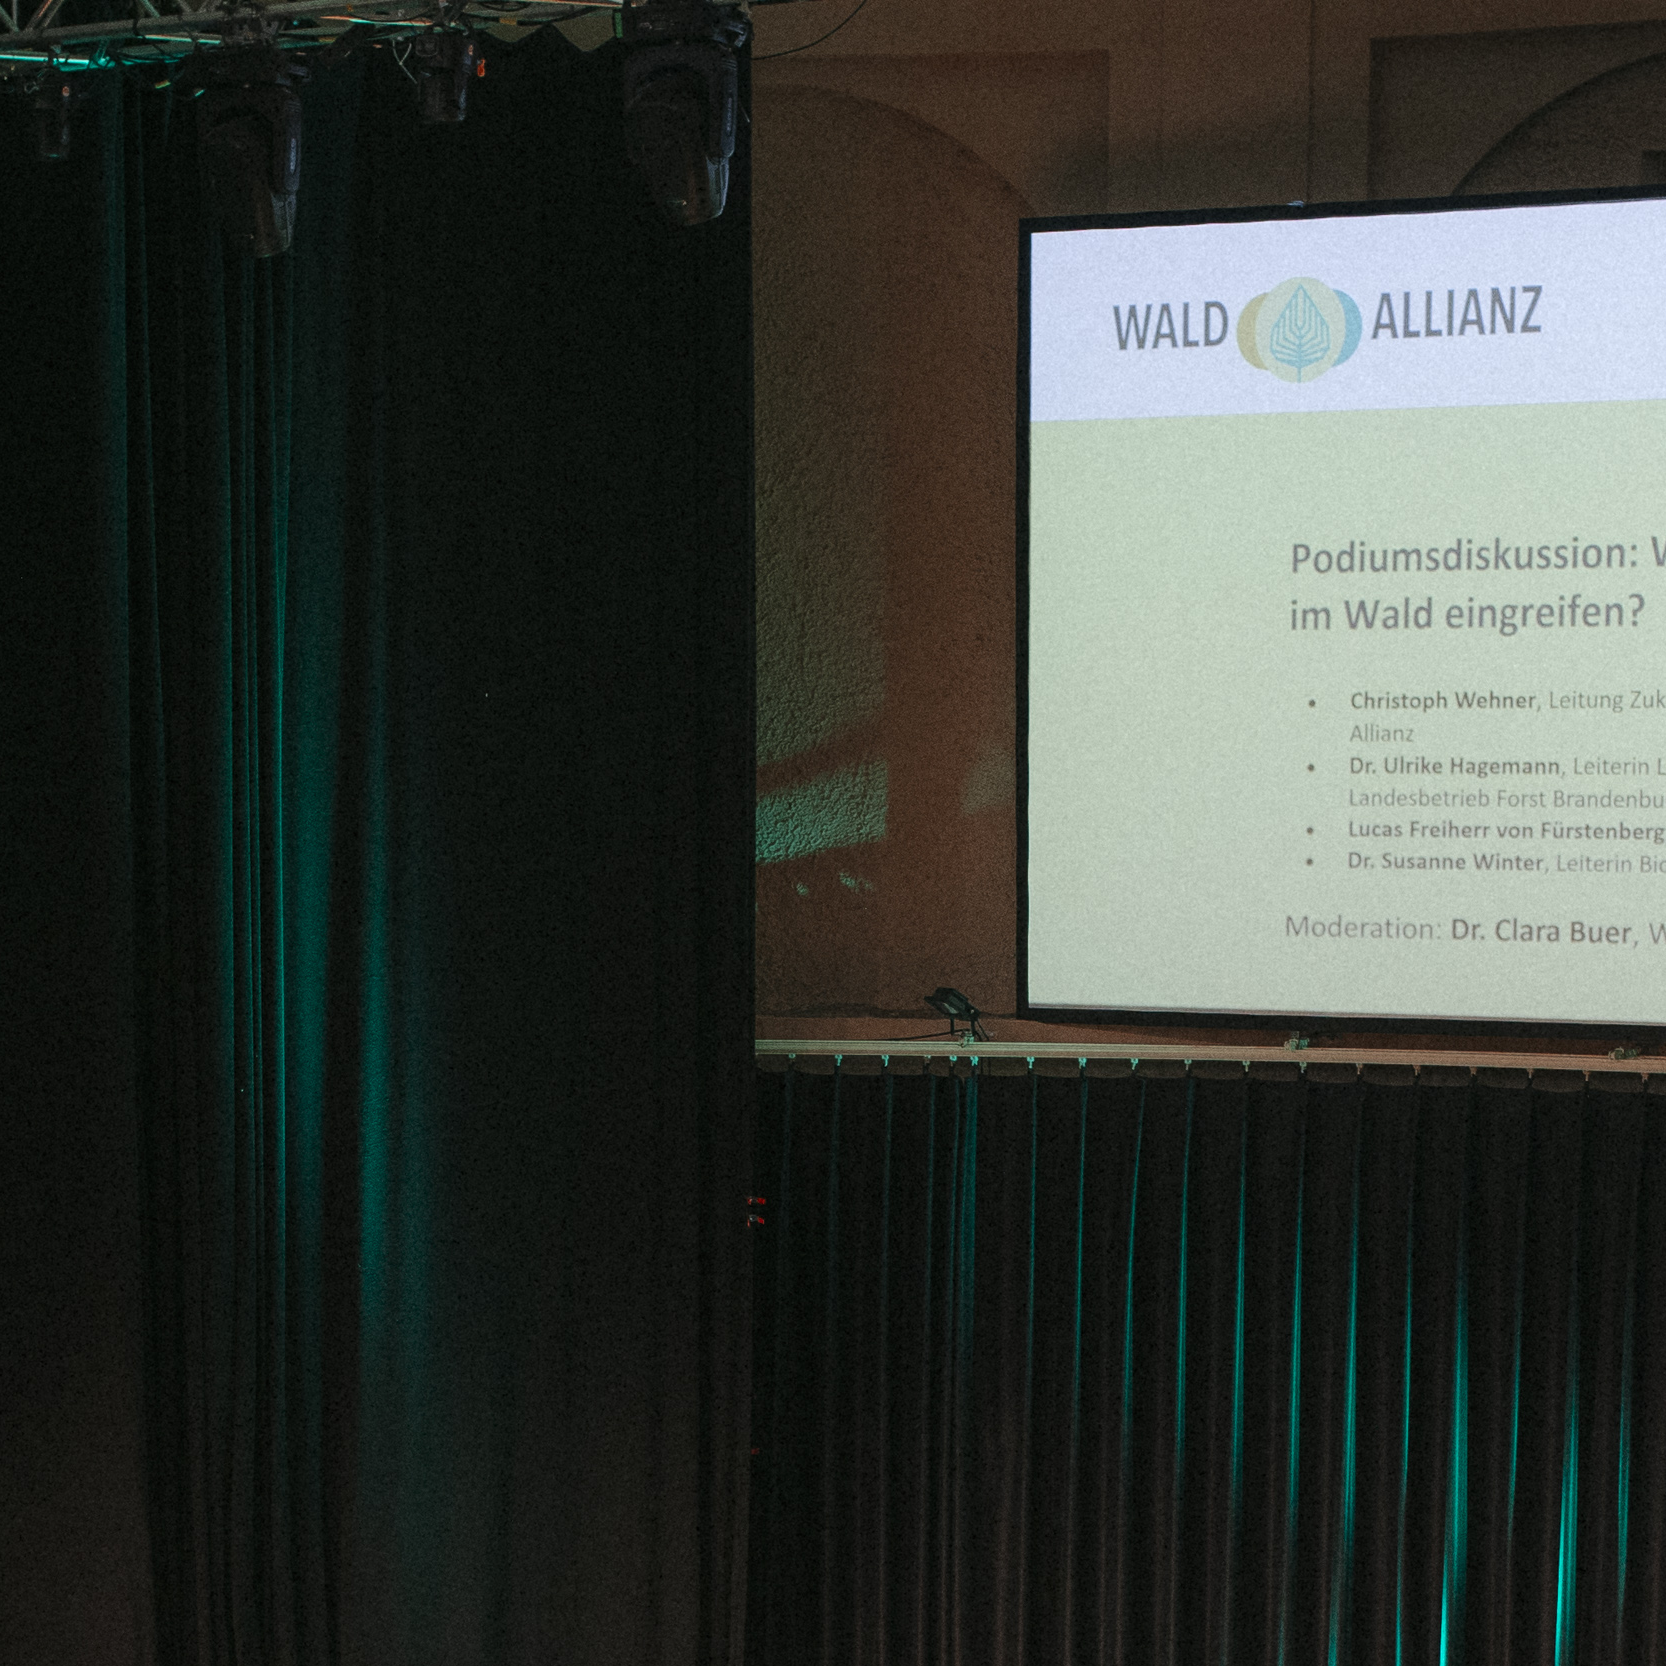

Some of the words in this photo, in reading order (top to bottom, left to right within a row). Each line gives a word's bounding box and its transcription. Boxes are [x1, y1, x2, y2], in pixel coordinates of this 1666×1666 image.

[1113, 301, 1229, 350] WALD
[1371, 285, 1543, 340] ALLIANZ
[1291, 538, 1639, 574] Podiumsdiskussion:
[1290, 600, 1332, 630] im
[1343, 597, 1433, 630] Wald
[1445, 593, 1646, 637] eingreifen?
[1350, 692, 1448, 713] Christoph
[1454, 692, 1542, 712] Wehner,
[1549, 691, 1624, 713] Leitung
[1349, 724, 1415, 743] Allianz
[1349, 757, 1376, 775] Dr.
[1384, 756, 1443, 776] Ulrike
[1450, 757, 1567, 779] Hagemann,
[1573, 756, 1650, 776] Leiterin
[1349, 788, 1490, 808] Landesbetrieb
[1497, 789, 1546, 808] Forst
[1349, 821, 1403, 839] Lucas
[1410, 821, 1491, 840] Freiherr
[1496, 826, 1534, 840] von
[1348, 852, 1375, 870] Dr.
[1382, 852, 1467, 871] Susanne
[1473, 852, 1549, 874] Winter,
[1556, 854, 1633, 873] Leiterin
[1284, 915, 1441, 940] Moderation:
[1451, 918, 1486, 941] Dr.
[1495, 918, 1561, 942] Clara
[1570, 920, 1639, 949] Buer,
